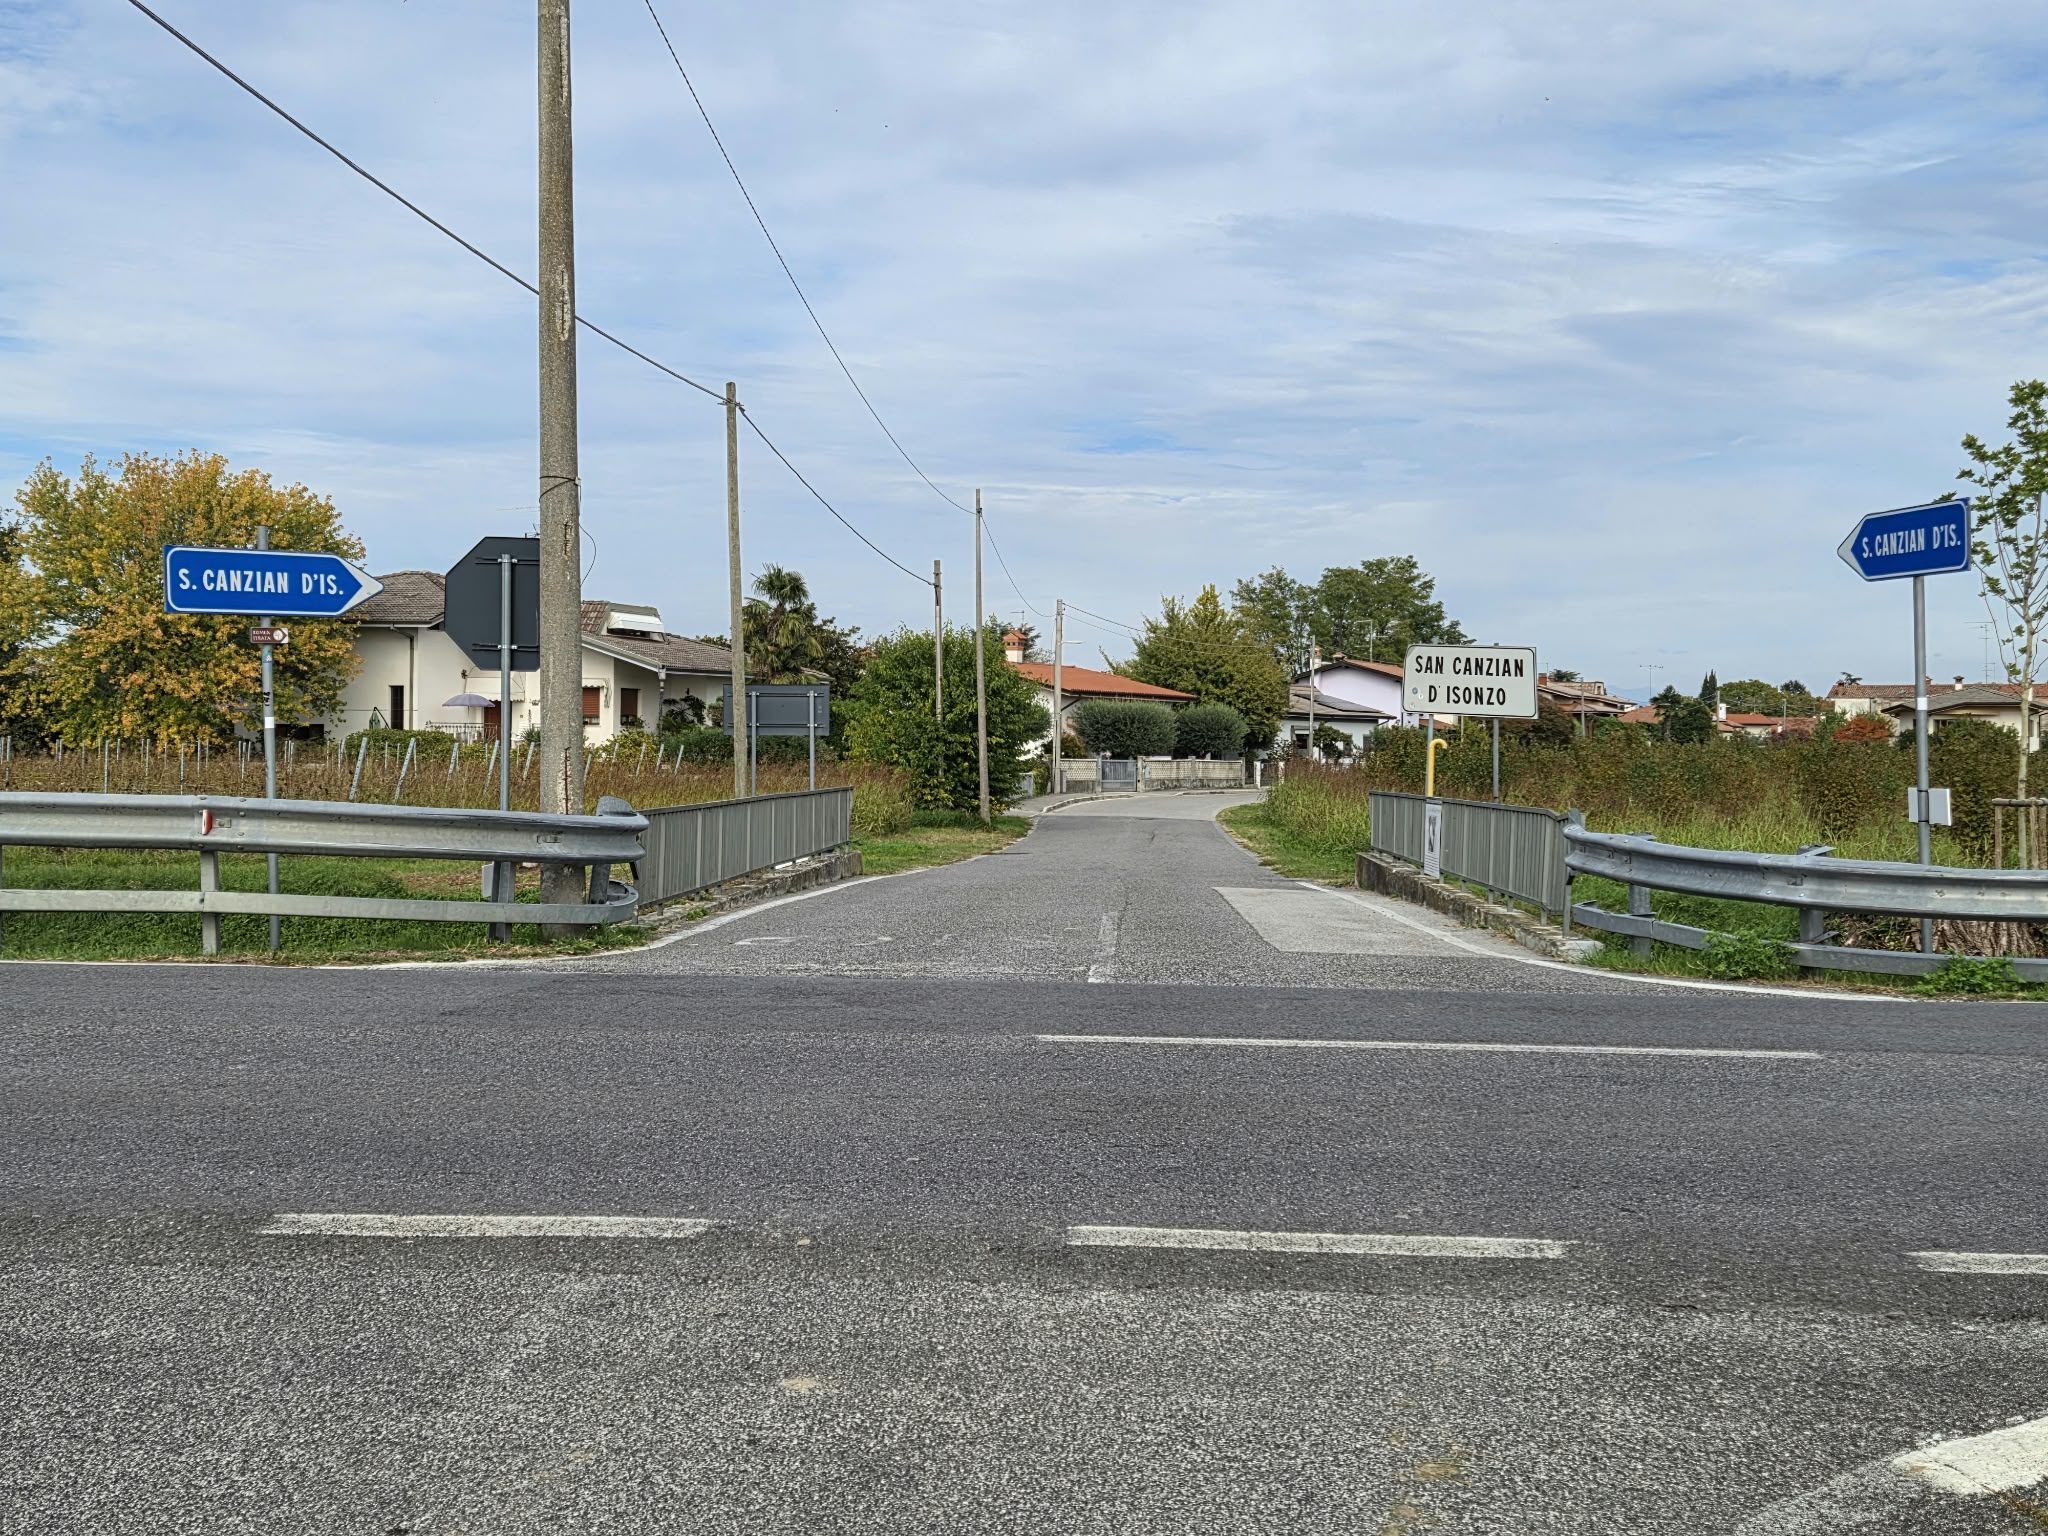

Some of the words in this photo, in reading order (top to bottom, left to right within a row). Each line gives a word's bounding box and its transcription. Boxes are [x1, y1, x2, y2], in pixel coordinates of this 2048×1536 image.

[1862, 536, 1873, 559] S.
[1874, 528, 1925, 557] CANZIAN
[1932, 523, 1961, 550] D'IS.
[178, 568, 198, 590] S.
[202, 569, 289, 594] CANZIAN
[301, 572, 344, 596] D'IS.
[1415, 655, 1444, 674] SAN
[1452, 656, 1524, 678] CANZIAN
